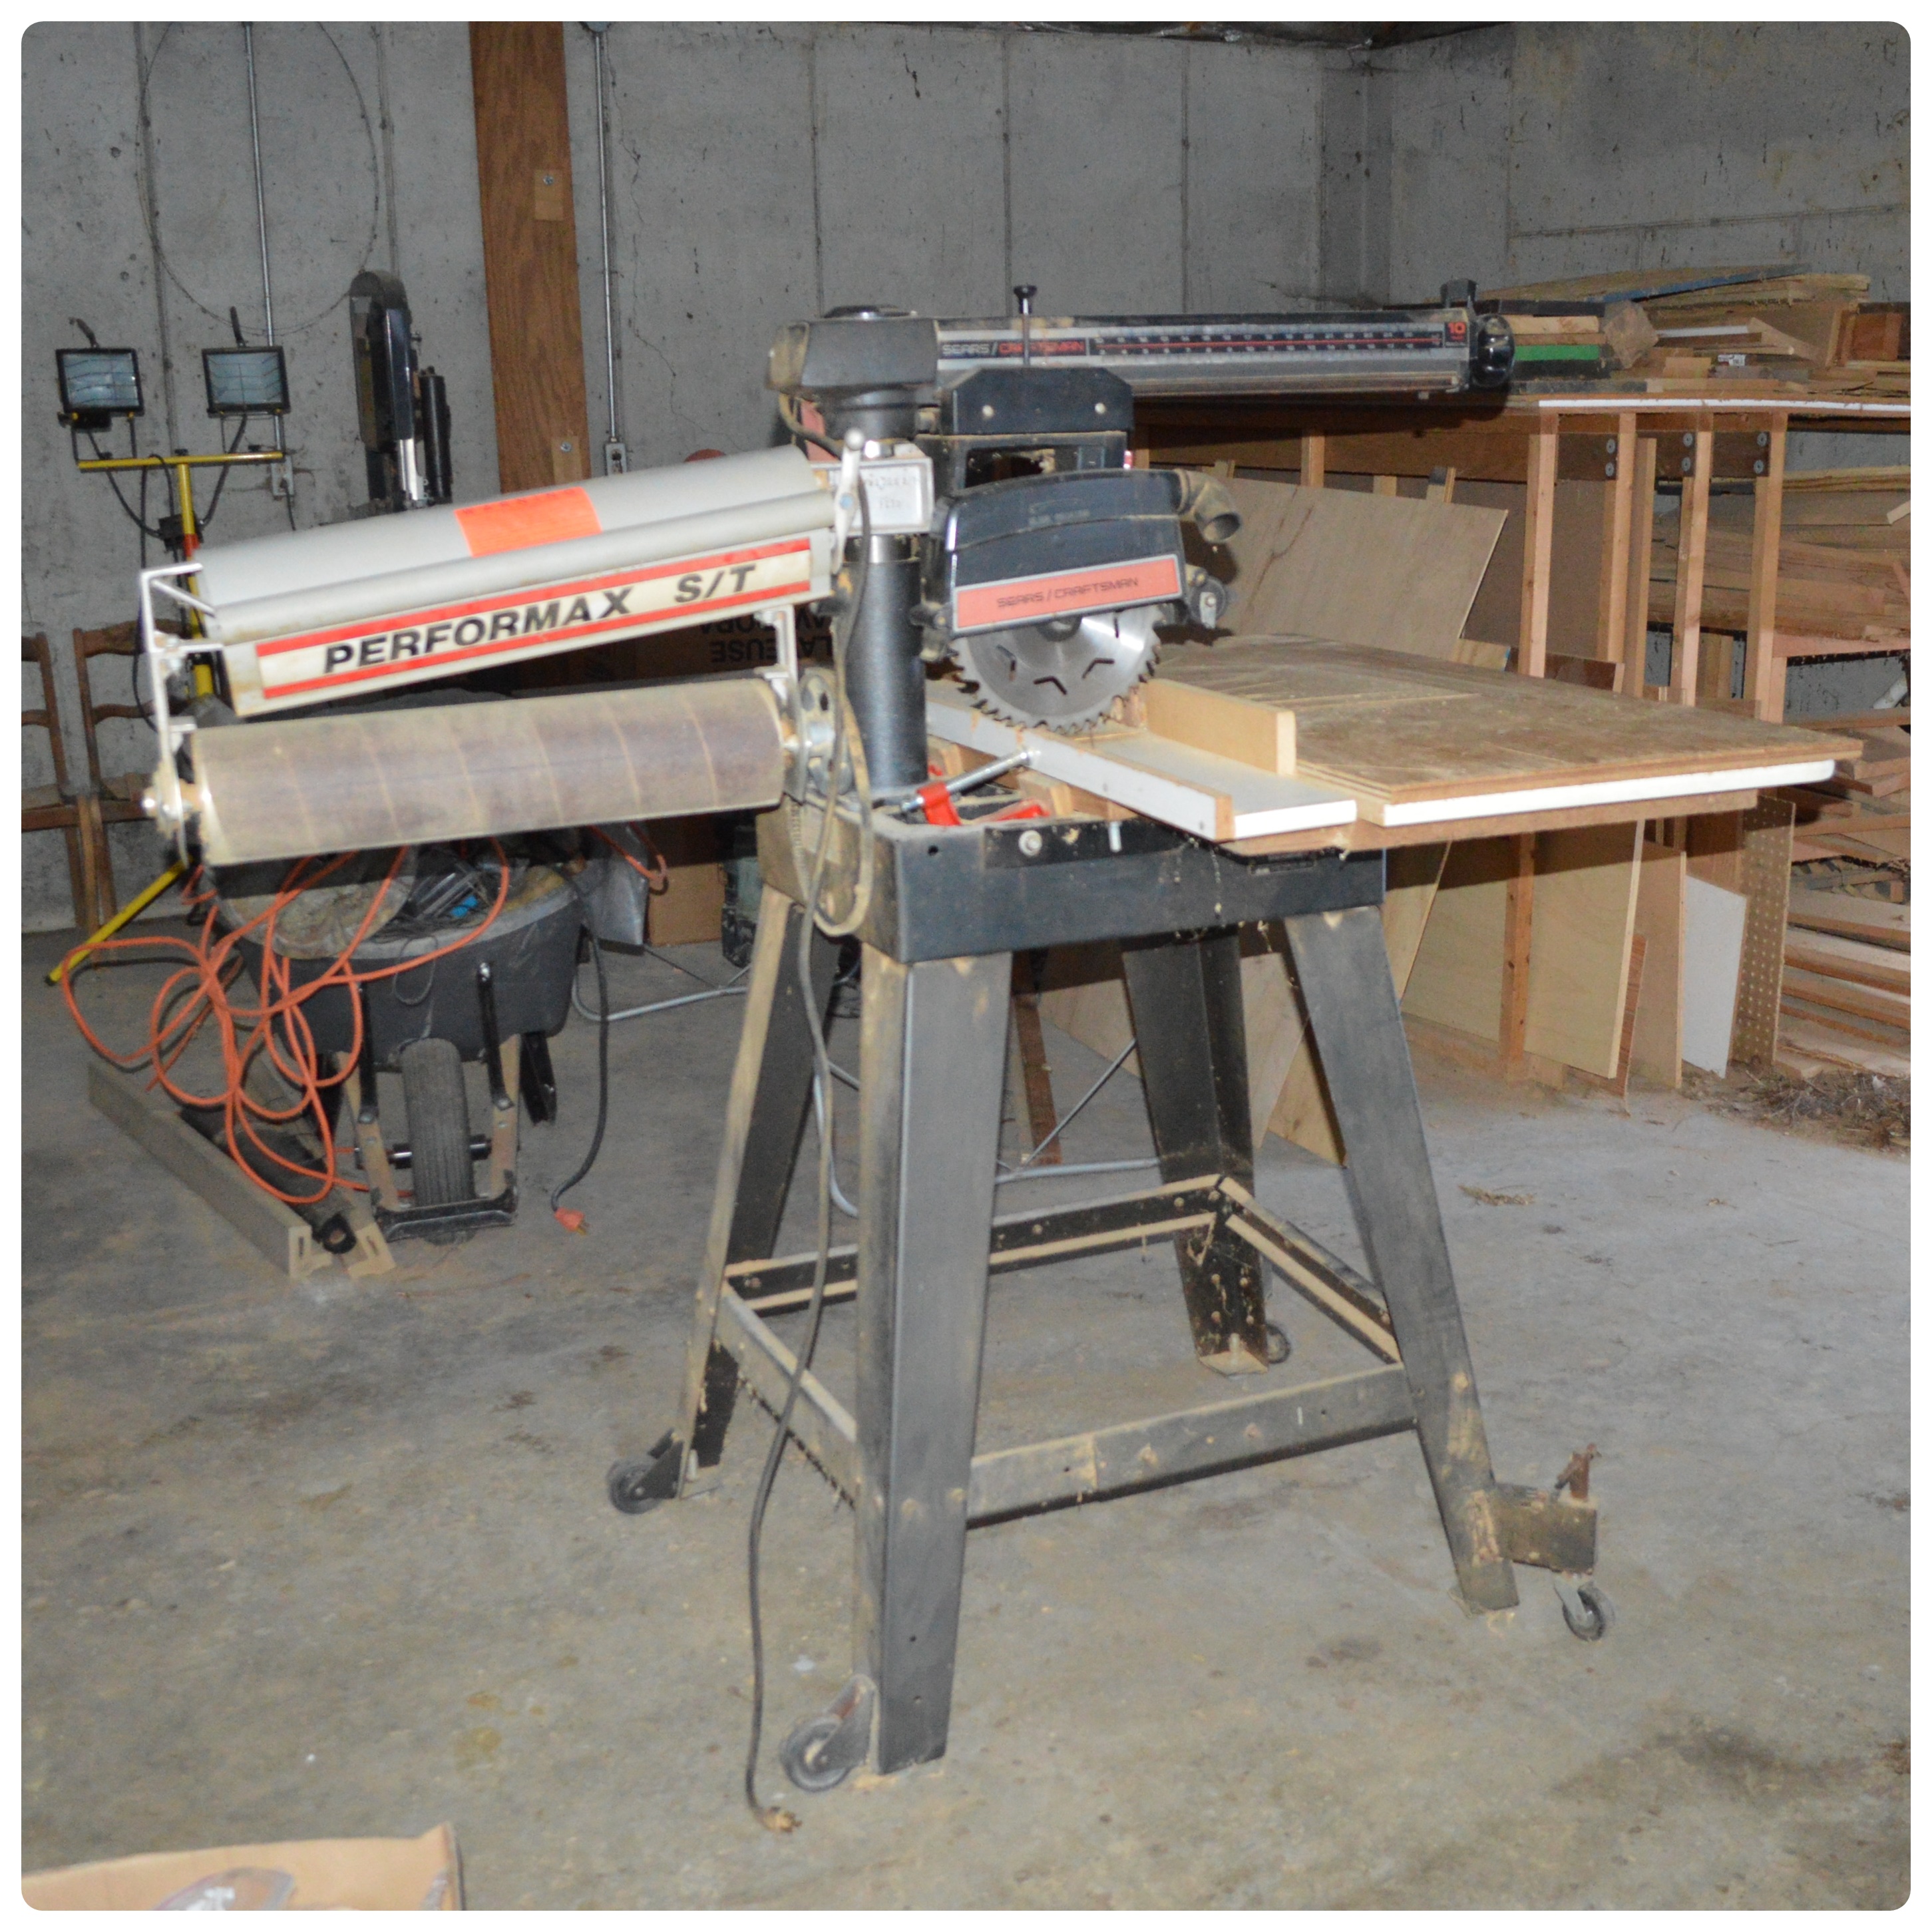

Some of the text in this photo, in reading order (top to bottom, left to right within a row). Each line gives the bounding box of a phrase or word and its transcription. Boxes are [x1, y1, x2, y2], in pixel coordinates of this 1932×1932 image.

[1448, 321, 1466, 334] 10
[997, 591, 1044, 608] SEARS
[1055, 578, 1139, 599] CRAFTSMAN
[323, 564, 756, 674] PERFORMAX S/T
